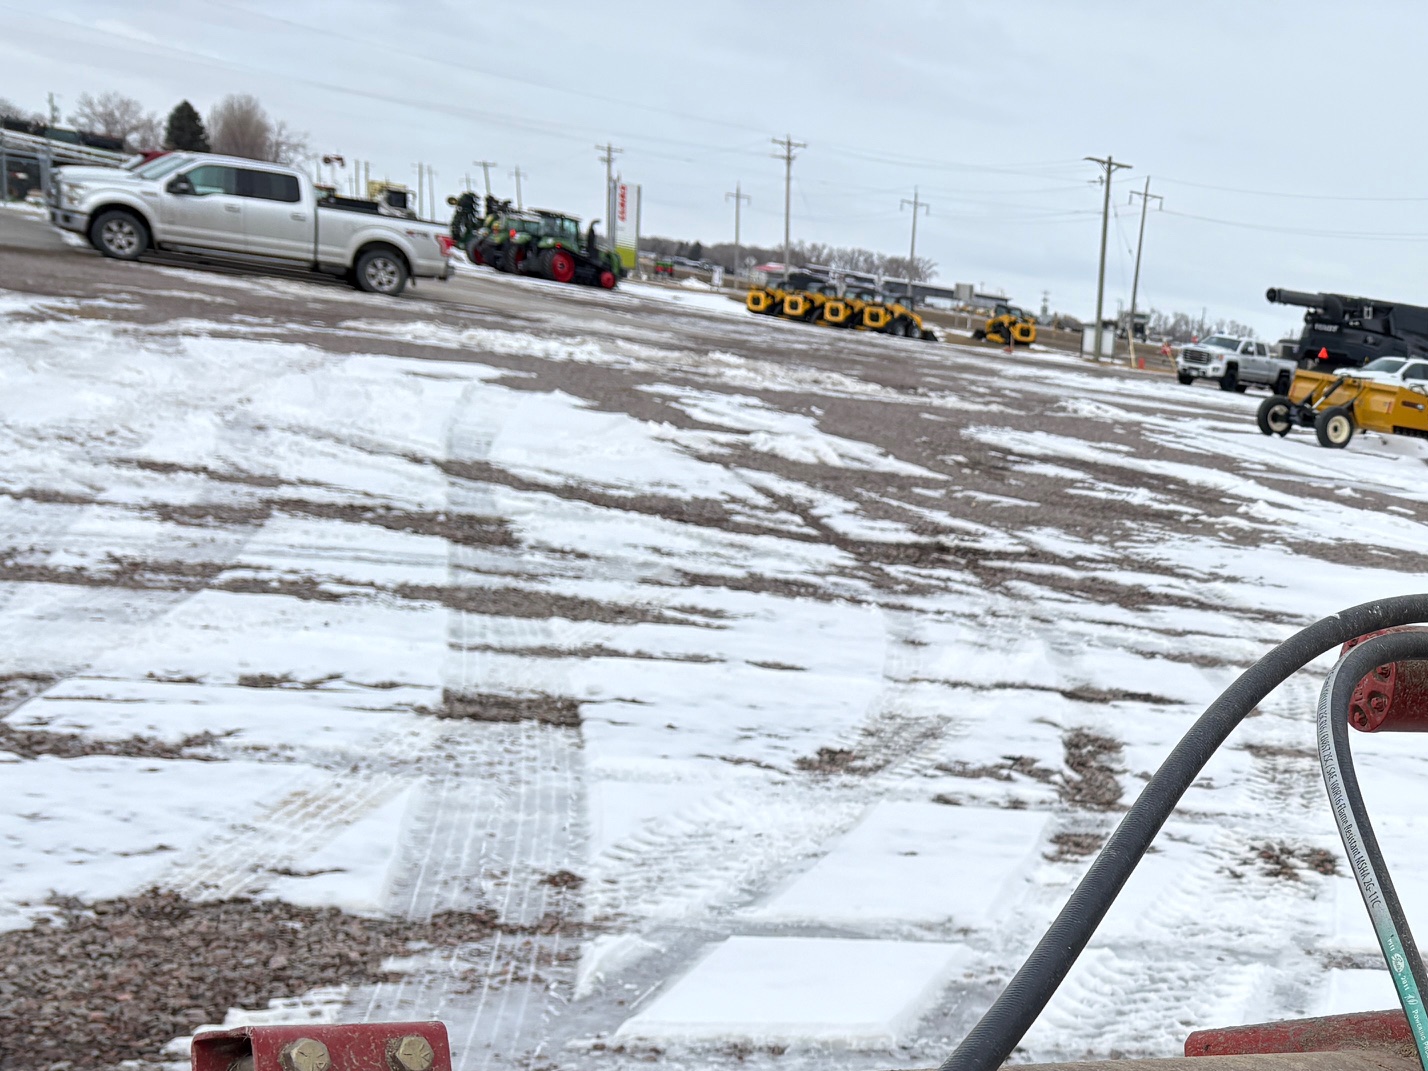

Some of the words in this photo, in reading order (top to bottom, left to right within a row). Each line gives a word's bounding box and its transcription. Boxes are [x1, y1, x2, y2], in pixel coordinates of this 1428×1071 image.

[1327, 767, 1337, 781] SAE
[1330, 780, 1343, 805] 100R16
[1339, 802, 1349, 823] Flame
[1344, 823, 1360, 858] Resistant
[1354, 856, 1371, 881] MSHA
[1363, 877, 1382, 908] 2G-11C
